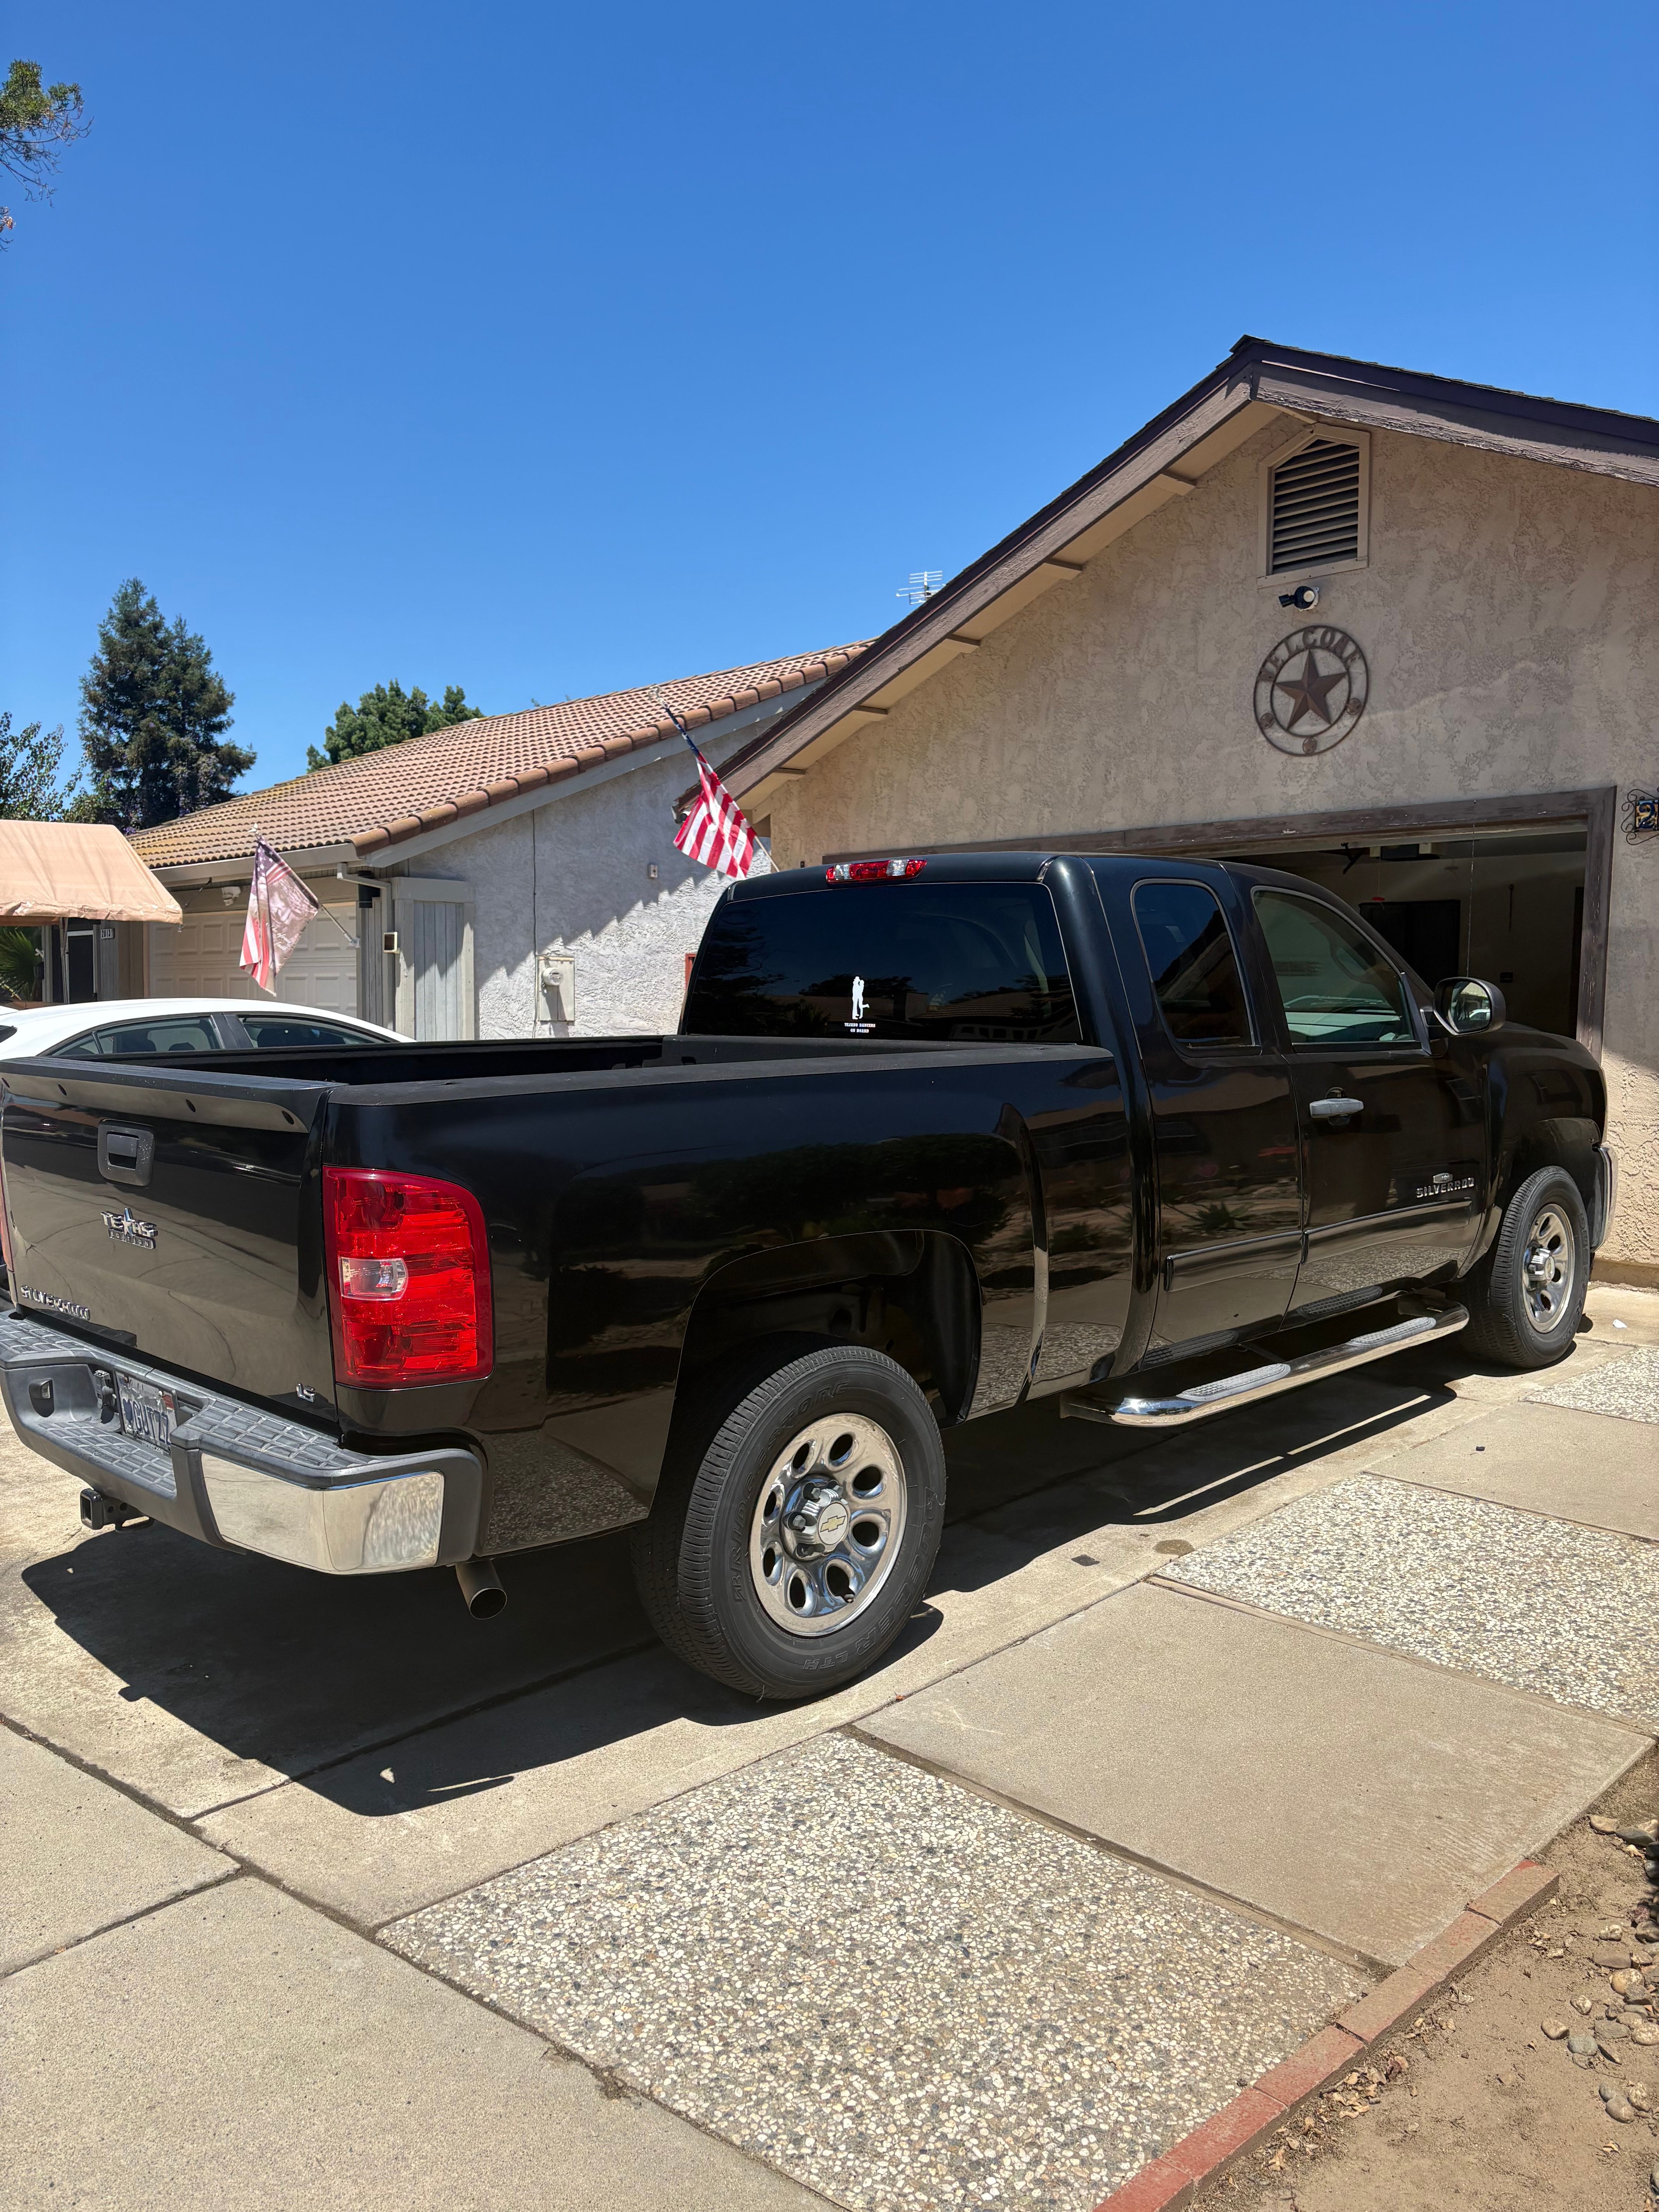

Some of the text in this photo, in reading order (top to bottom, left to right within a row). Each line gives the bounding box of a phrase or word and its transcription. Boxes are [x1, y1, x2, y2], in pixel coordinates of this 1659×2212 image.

[1638, 802, 1655, 829] 2
[1416, 1177, 1474, 1198] SILVERADO
[110, 1229, 153, 1248] EDITION
[21, 1285, 91, 1321] SILVERADO
[296, 1382, 315, 1402] LS
[730, 1378, 851, 1602] BRIDGESTONE
[803, 1486, 937, 1671] DUELER LTH
